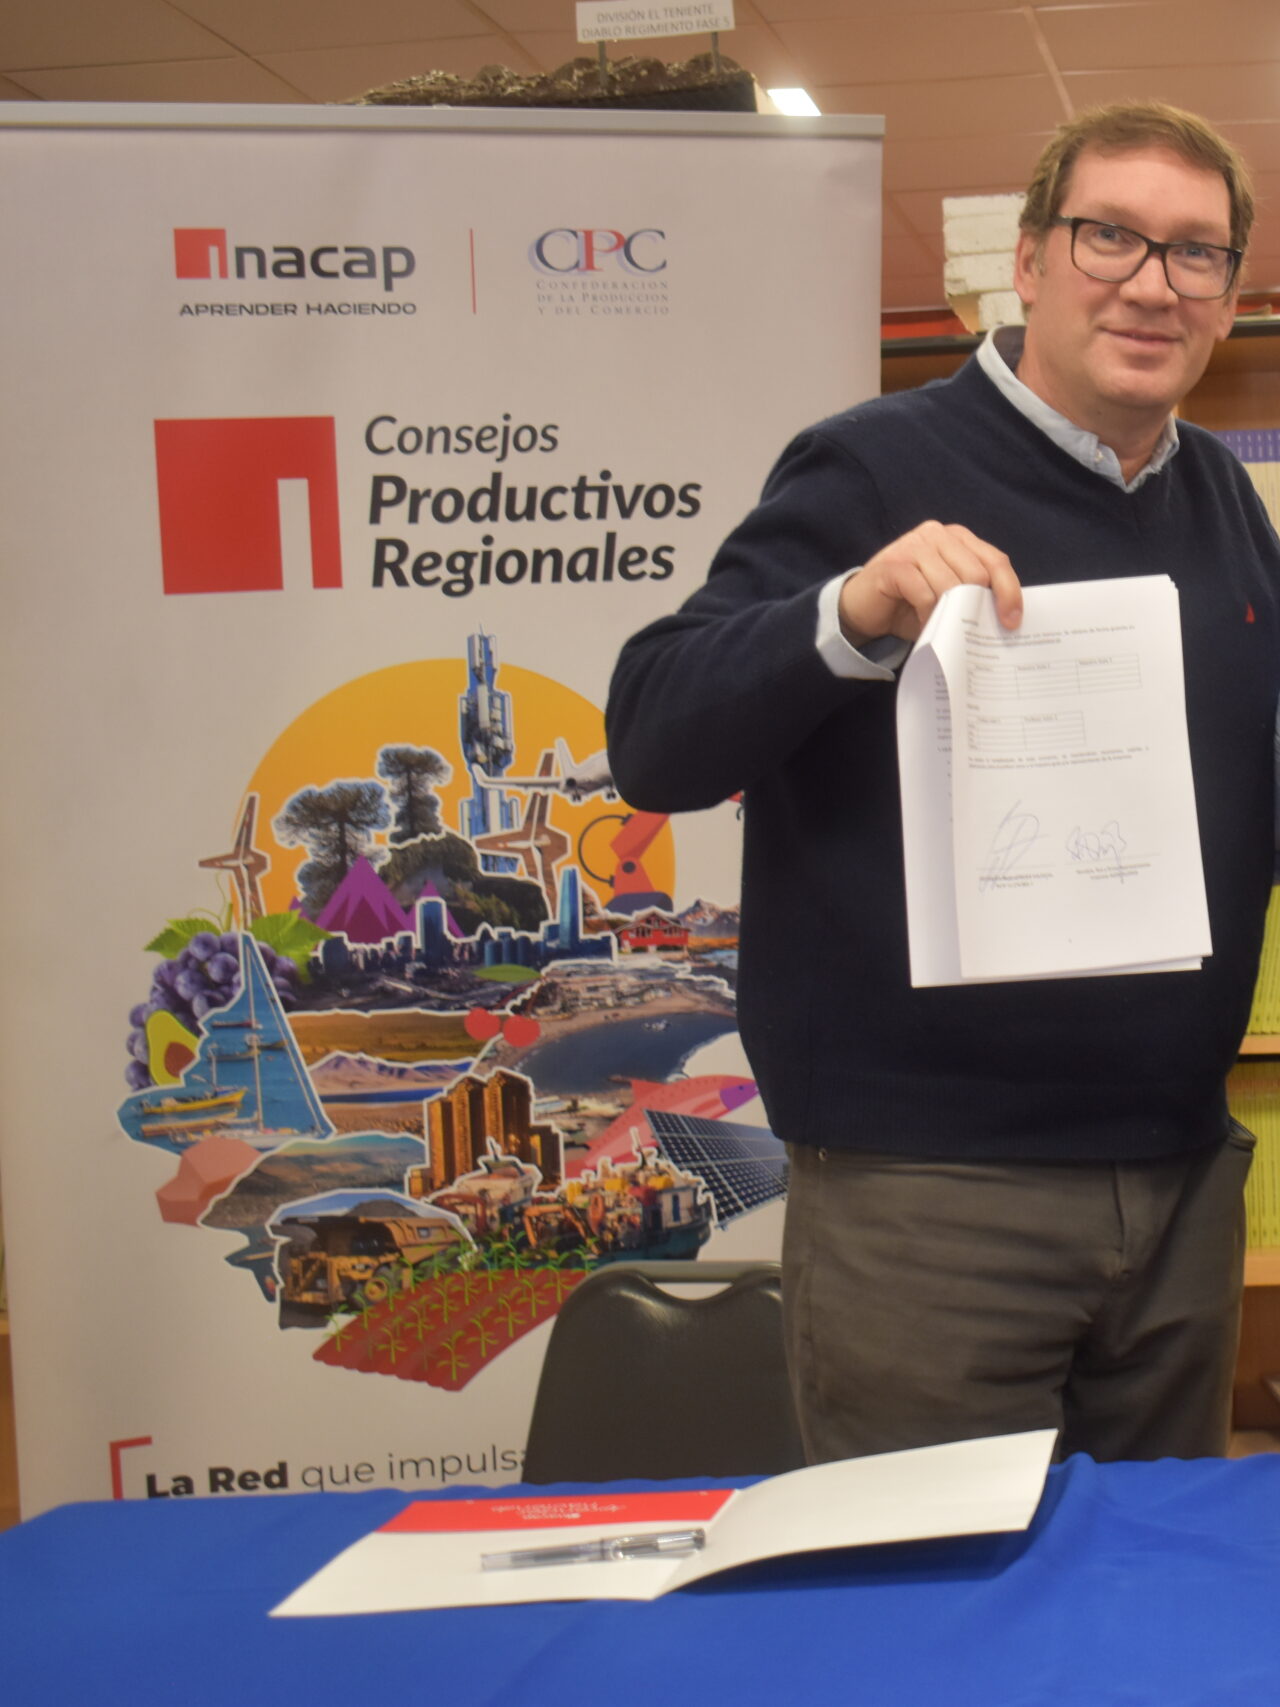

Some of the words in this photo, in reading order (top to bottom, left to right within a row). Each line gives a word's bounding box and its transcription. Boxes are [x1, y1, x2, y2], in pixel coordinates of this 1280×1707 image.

[596, 9, 646, 24] DIVISIÓN
[648, 8, 660, 20] EL
[663, 3, 714, 19] TENIENTE
[528, 228, 667, 277] CPC
[179, 303, 298, 316] APRENDER
[306, 303, 417, 315] HACIENDO
[364, 413, 560, 463] Consejos
[368, 469, 703, 526] Productivos
[371, 531, 677, 598] Regionales
[146, 1473, 194, 1498] La
[208, 1462, 289, 1494] Red
[301, 1463, 376, 1492] que
